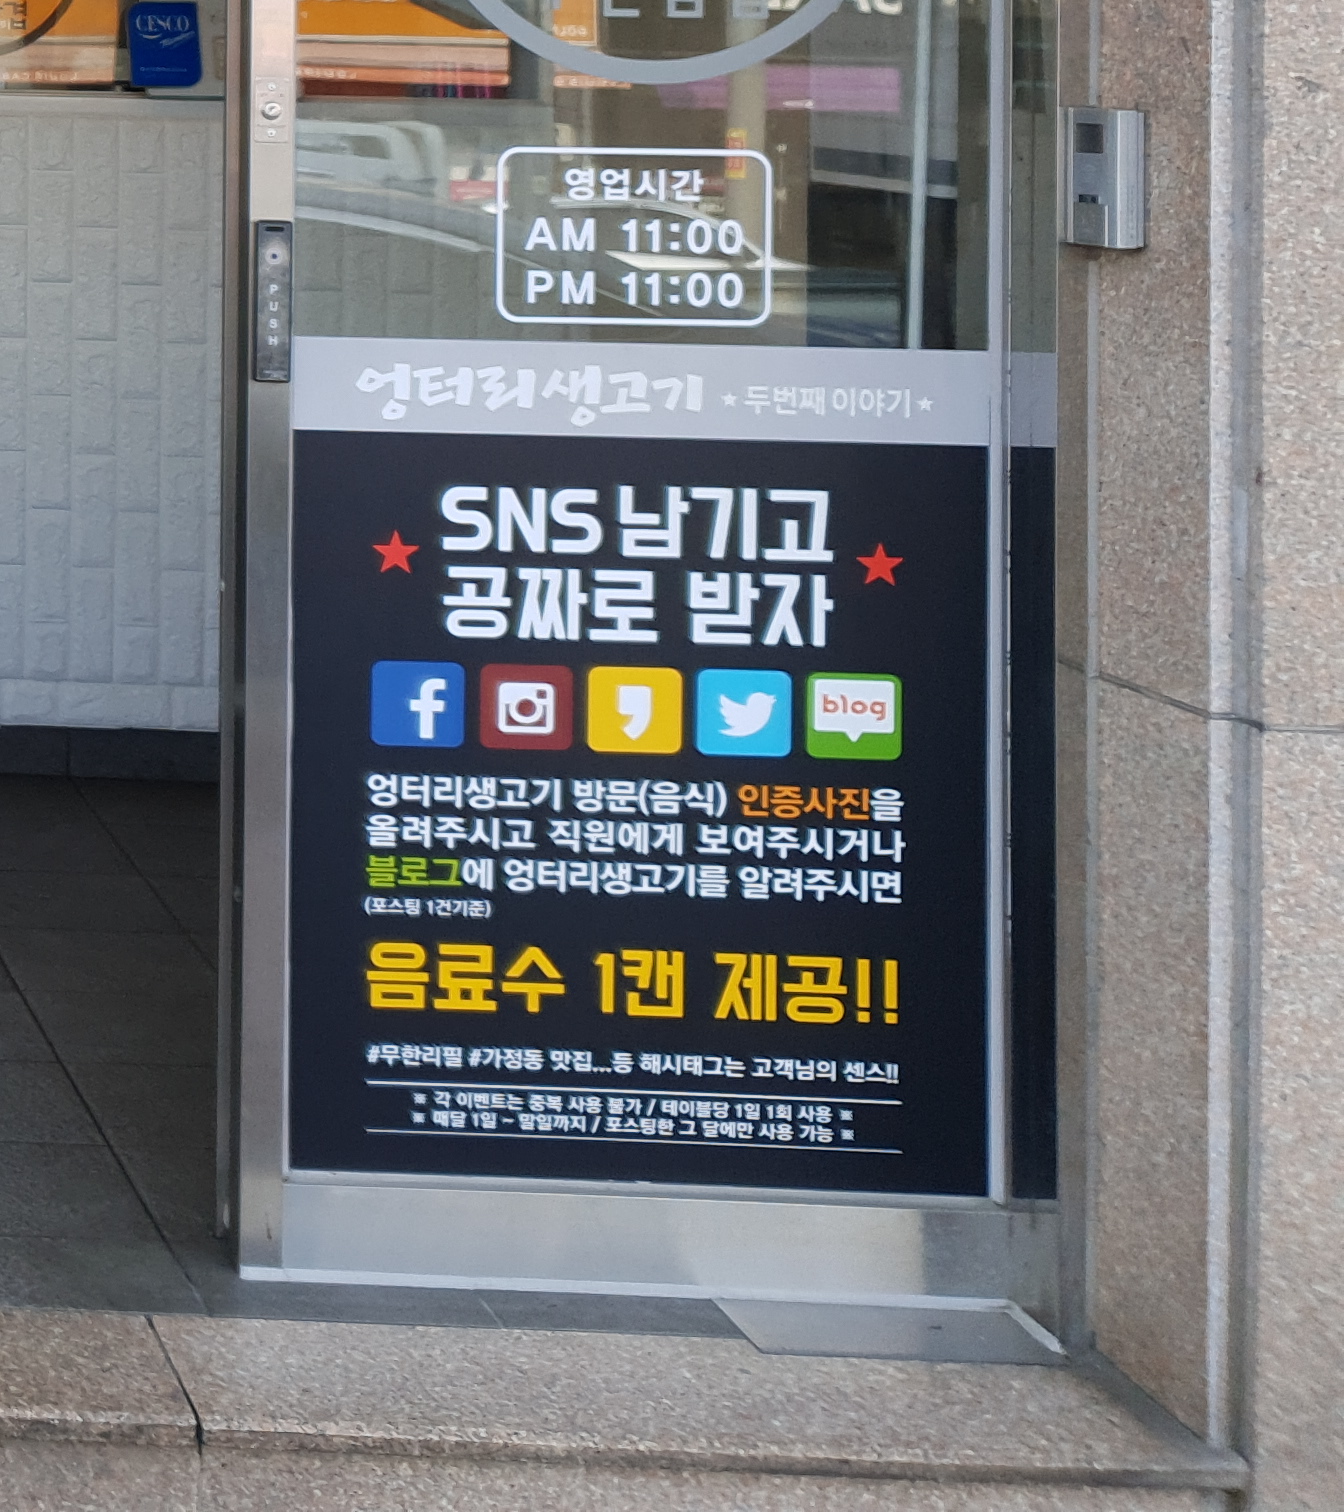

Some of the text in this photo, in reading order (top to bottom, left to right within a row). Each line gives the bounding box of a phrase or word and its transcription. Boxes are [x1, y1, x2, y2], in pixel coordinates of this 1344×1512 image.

[563, 169, 705, 203] 영업시간
[524, 217, 745, 255] AM 11:00
[524, 271, 745, 309] PM 11:00
[355, 362, 912, 428] 엉터리생고기 두번째 이야기
[439, 488, 836, 563] SNS 남기고
[441, 567, 834, 648] 공짜로 받자
[821, 693, 888, 721] blog
[366, 773, 905, 823] 엉터리생고기 방문(음식) 인증사진을
[365, 813, 907, 864] 올려주시고 직원에게 보여주시거나
[365, 854, 903, 905] 블로그에 엉터리생고기를 알려주시면
[364, 896, 492, 919] (포스팅 1건기준)
[365, 941, 901, 1025] 음료수 1캔 제공!!
[366, 1043, 463, 1069] #무한리필
[468, 1046, 546, 1071] #가정동
[638, 1052, 747, 1079] 해시태그는
[750, 1056, 838, 1083] 고객님의
[842, 1059, 901, 1085] 센스!!
[431, 1110, 467, 1129] 매달
[471, 1111, 499, 1130] 1일
[518, 1112, 587, 1133] 말일까지
[604, 1115, 675, 1137] 포스팅한
[678, 1120, 699, 1136] 그
[700, 1120, 755, 1140] 달에만
[758, 1122, 796, 1142] 사용
[798, 1124, 835, 1144] 가능
[433, 1091, 451, 1109] 각
[455, 1091, 525, 1111] 이벤트는
[527, 1094, 564, 1113] 중복
[567, 1096, 603, 1114] 사용
[660, 1099, 731, 1119] 테이블당
[734, 1102, 761, 1120] 1일
[796, 1105, 834, 1124] 사용
